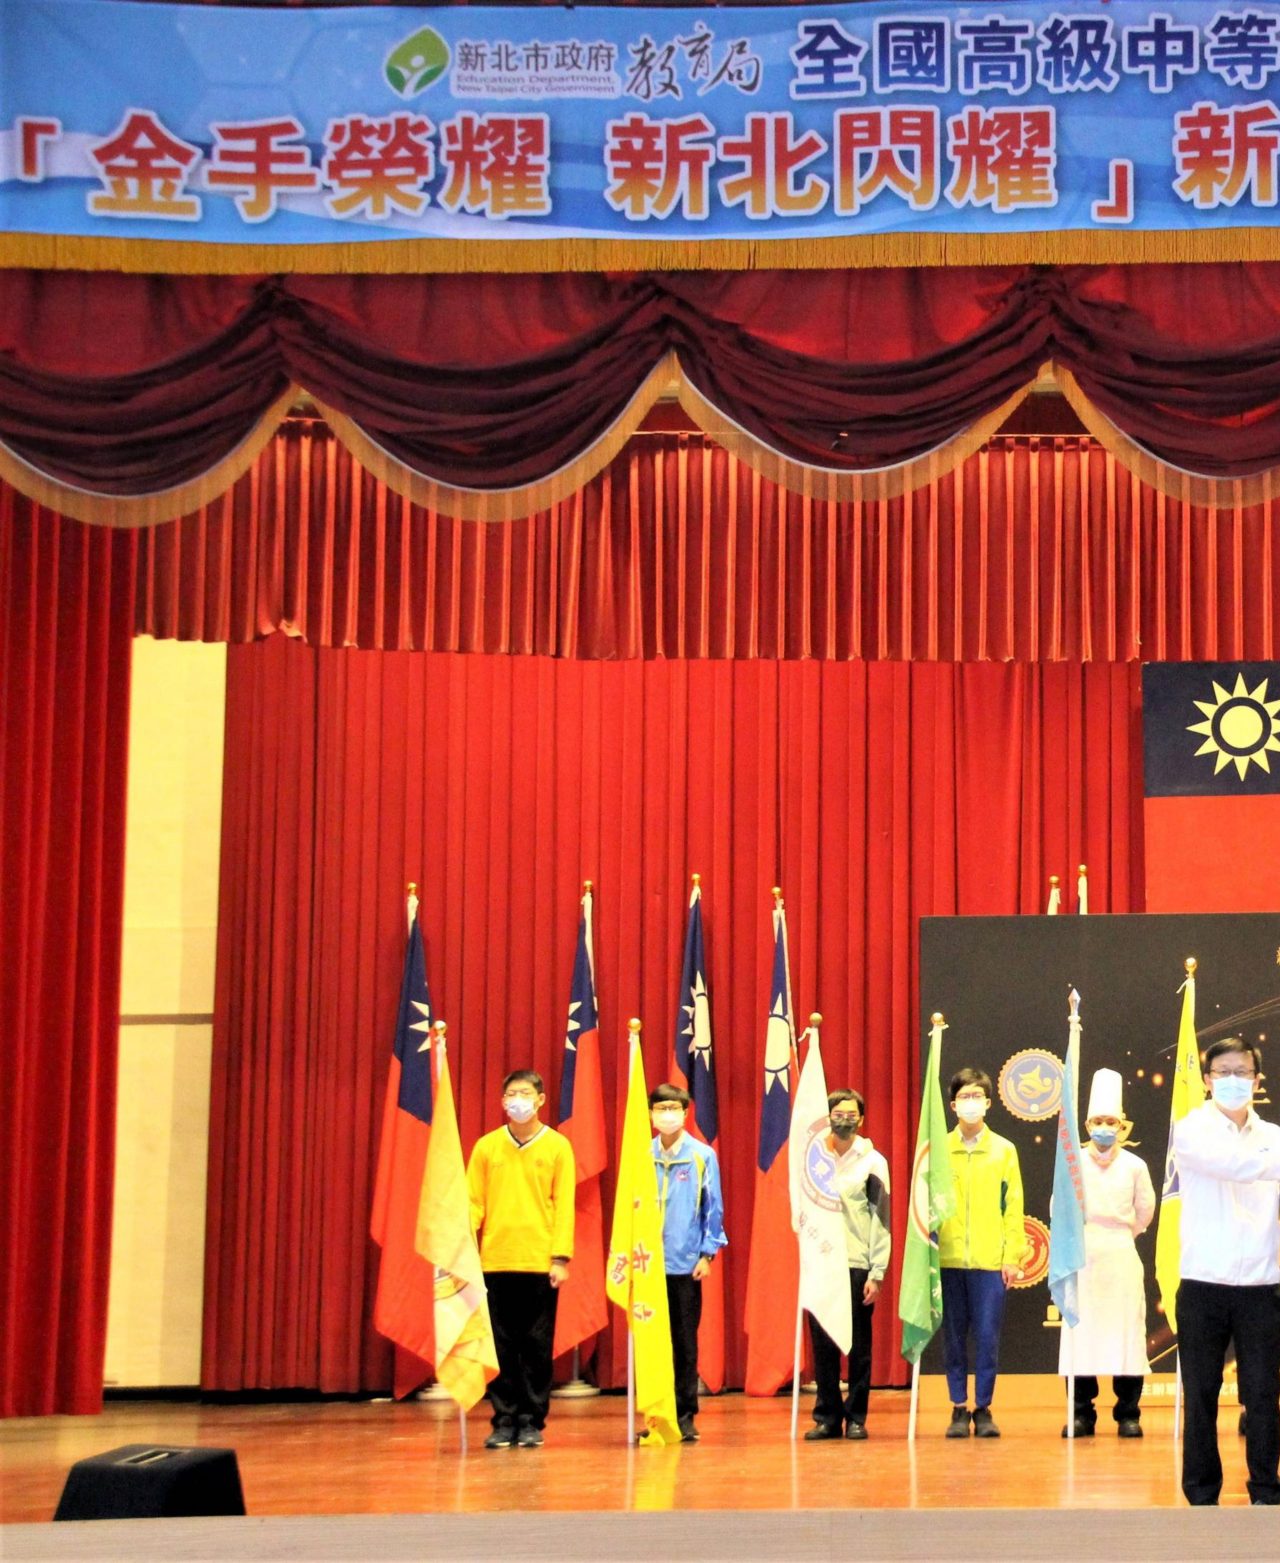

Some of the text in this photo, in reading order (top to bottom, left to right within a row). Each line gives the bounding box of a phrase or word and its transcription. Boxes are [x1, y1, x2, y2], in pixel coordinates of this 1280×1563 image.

[458, 25, 761, 99] 新北市政府 教育局
[456, 75, 525, 83] Education
[456, 84, 481, 92] New
[485, 84, 518, 94] Taipei
[520, 85, 543, 94] City
